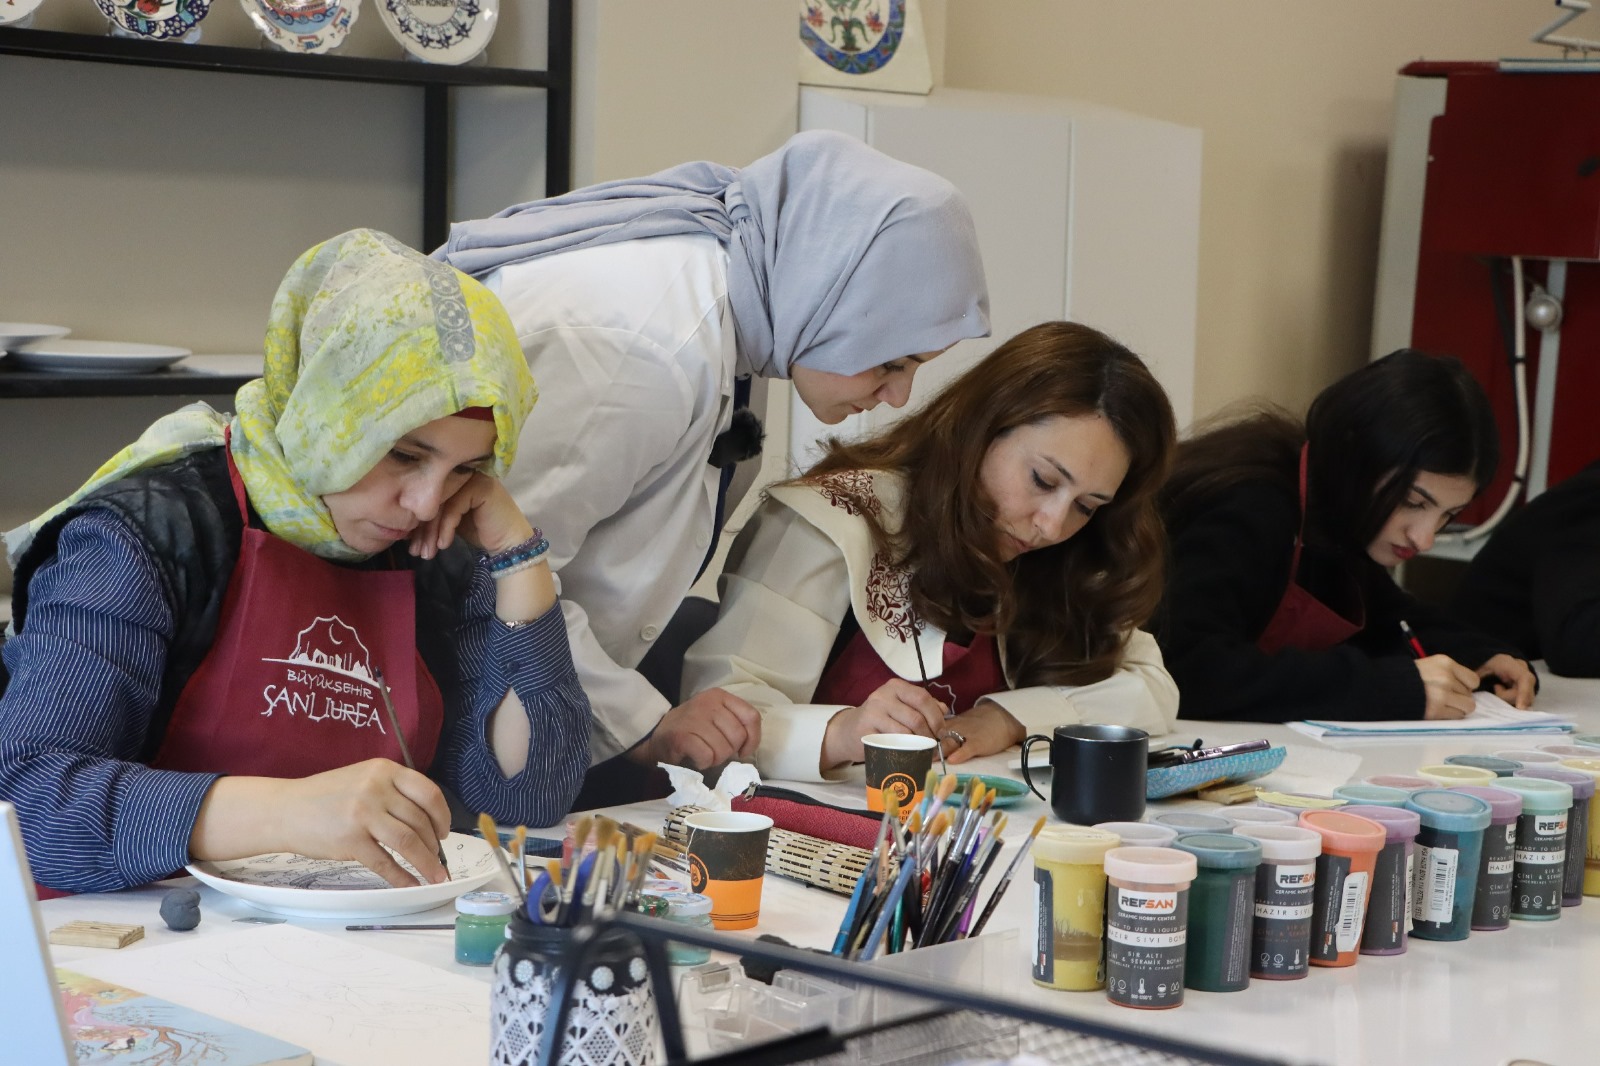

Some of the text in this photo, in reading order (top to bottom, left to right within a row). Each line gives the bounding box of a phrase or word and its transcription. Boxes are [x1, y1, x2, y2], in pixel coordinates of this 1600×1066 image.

[287, 668, 373, 700] BÜYÜKŞEHİR
[1121, 895, 1174, 909] REFSAN
[1118, 911, 1138, 920] CERAMIC
[1256, 907, 1287, 916] HAZIR
